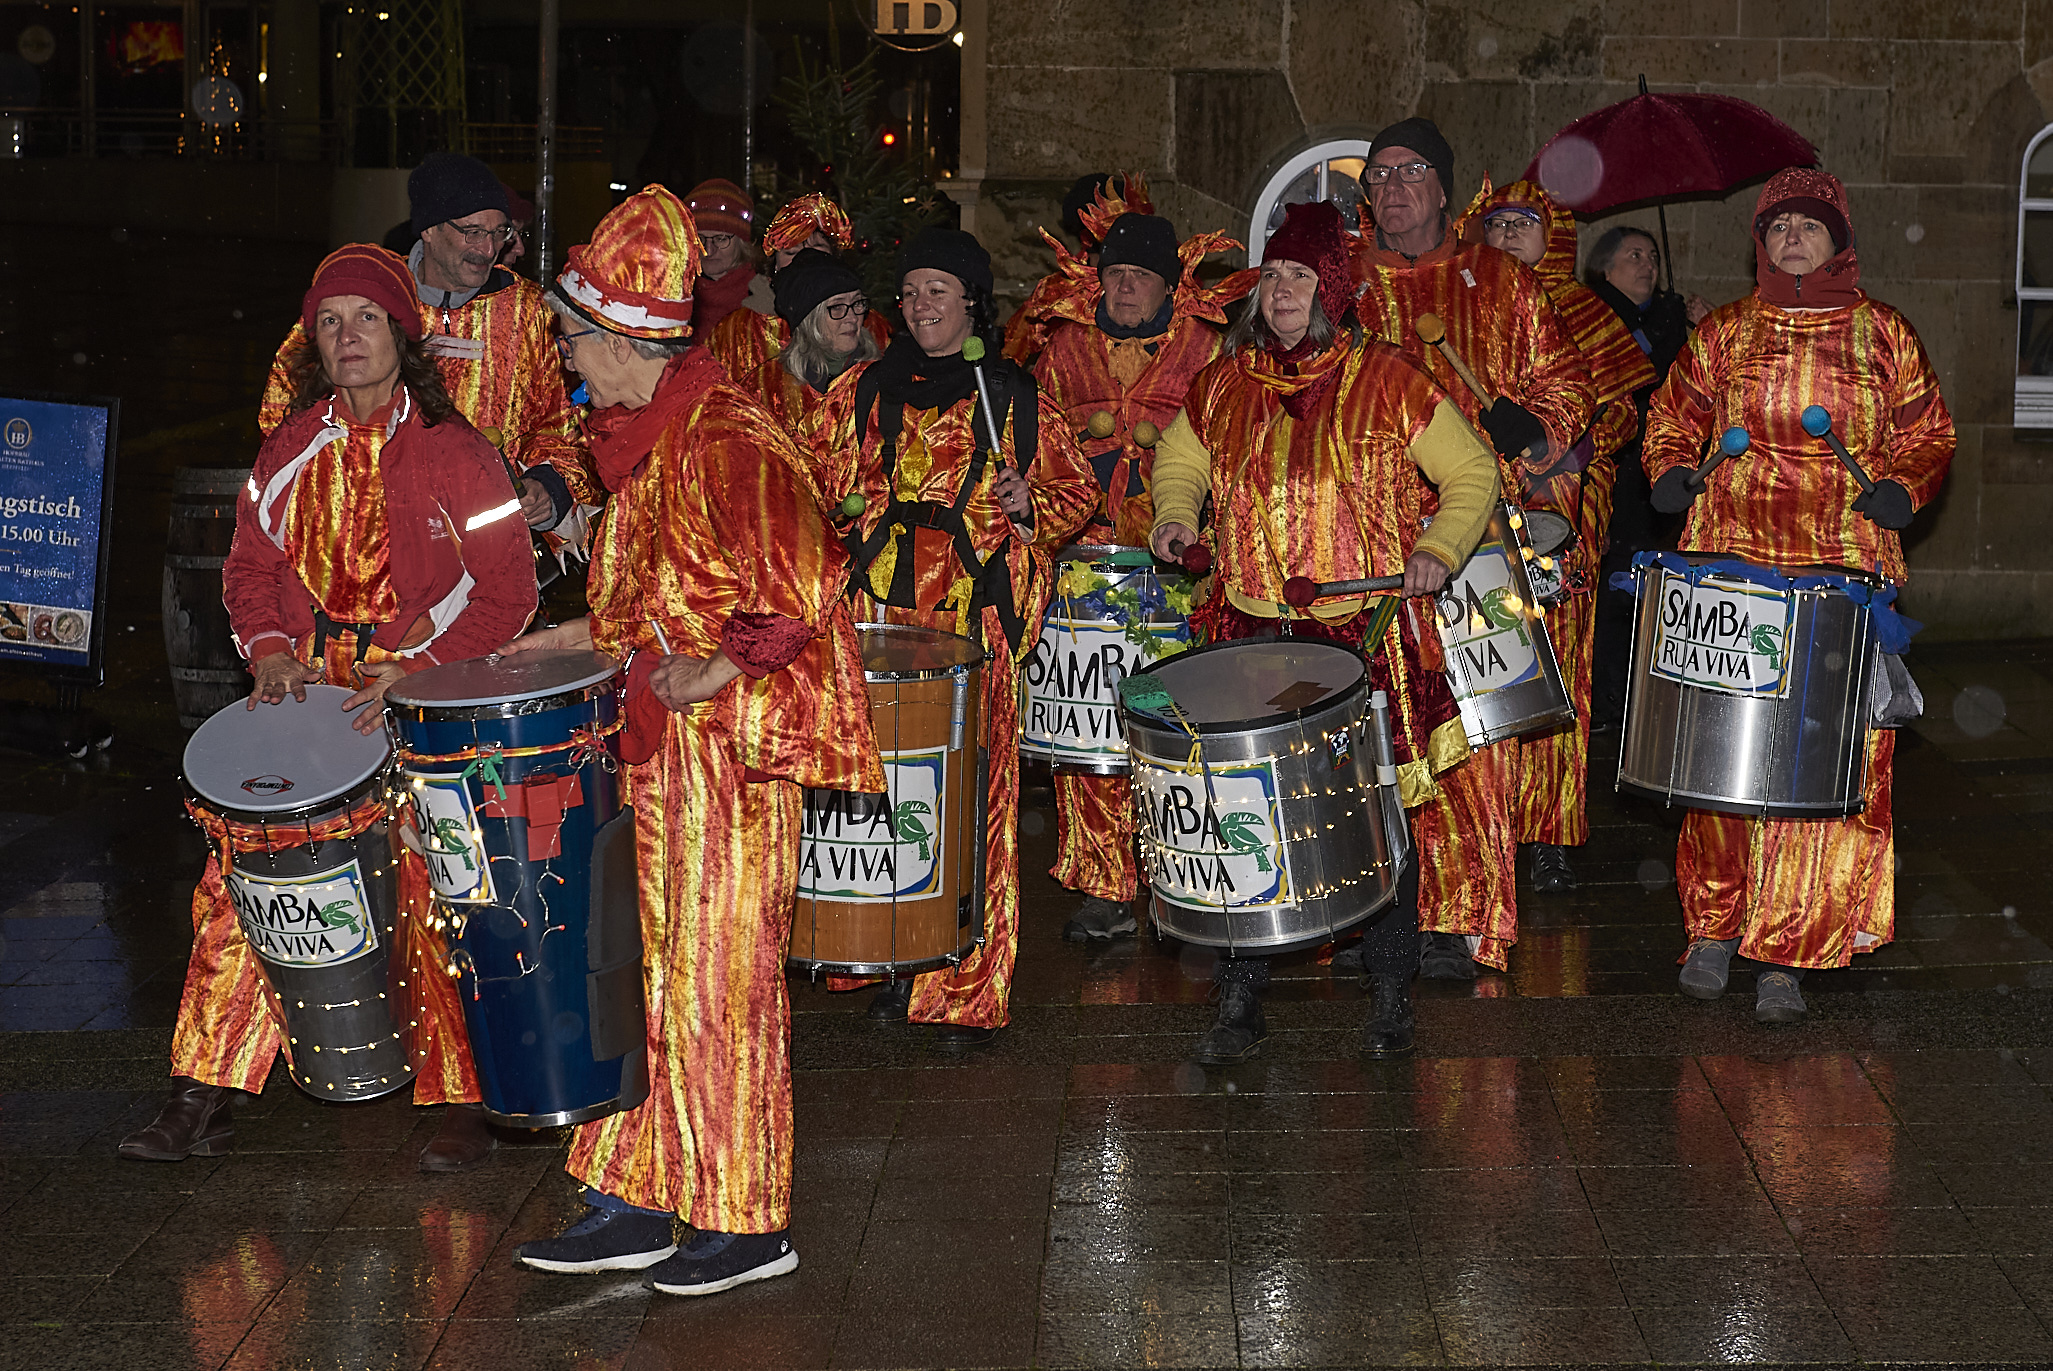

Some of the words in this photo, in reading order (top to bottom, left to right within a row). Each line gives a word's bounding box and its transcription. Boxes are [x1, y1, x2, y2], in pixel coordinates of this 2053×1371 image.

[1, 525, 43, 543] 15.00
[49, 529, 80, 547] Uhr
[14, 563, 31, 577] Tag
[1663, 588, 1755, 650] SAMBA
[1663, 639, 1700, 672] RUA
[1706, 649, 1751, 681] VIVA
[1031, 701, 1081, 738] RUA
[829, 846, 894, 882] VIVA
[1172, 852, 1236, 893] VIVA
[226, 875, 329, 931] SAMBA
[279, 933, 336, 956] VIVA
